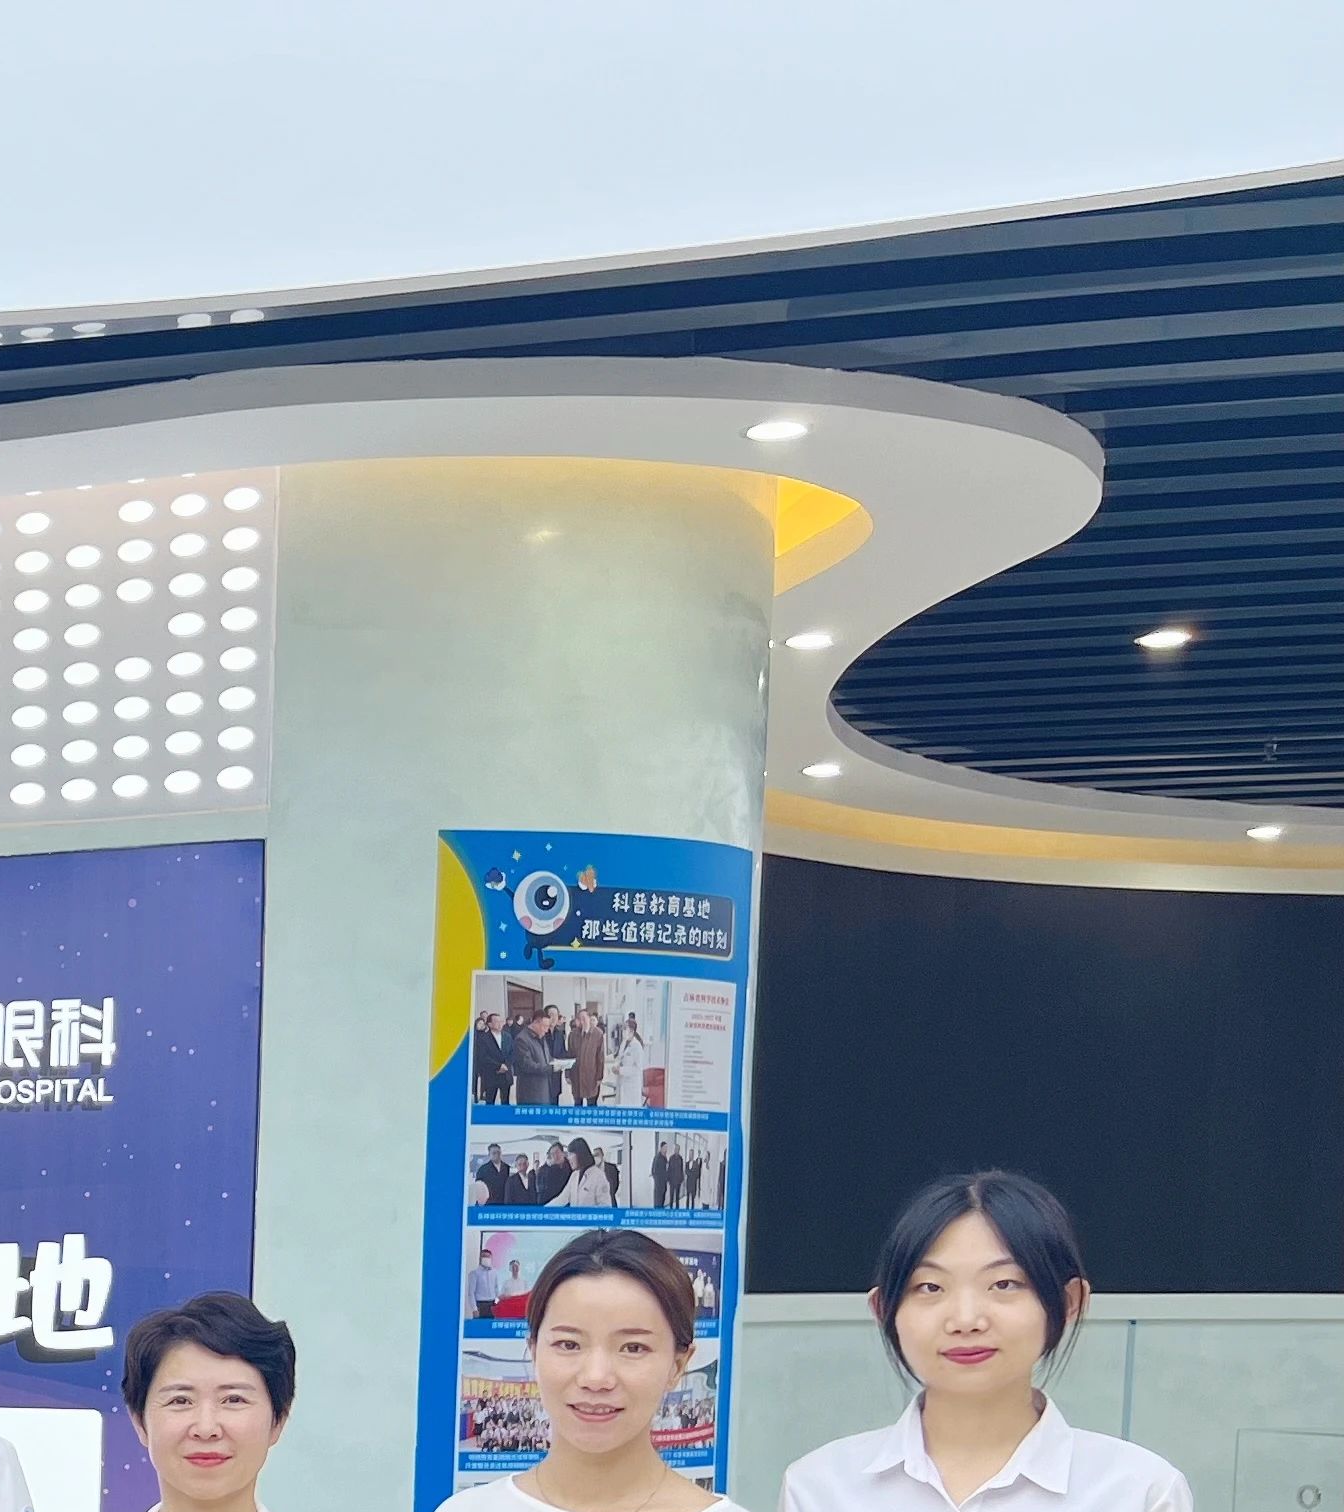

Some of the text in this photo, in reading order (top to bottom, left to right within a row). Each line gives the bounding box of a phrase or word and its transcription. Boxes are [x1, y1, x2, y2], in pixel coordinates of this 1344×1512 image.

[612, 892, 711, 920] 科普教育基地
[581, 919, 728, 950] 那些值得记录的时刻
